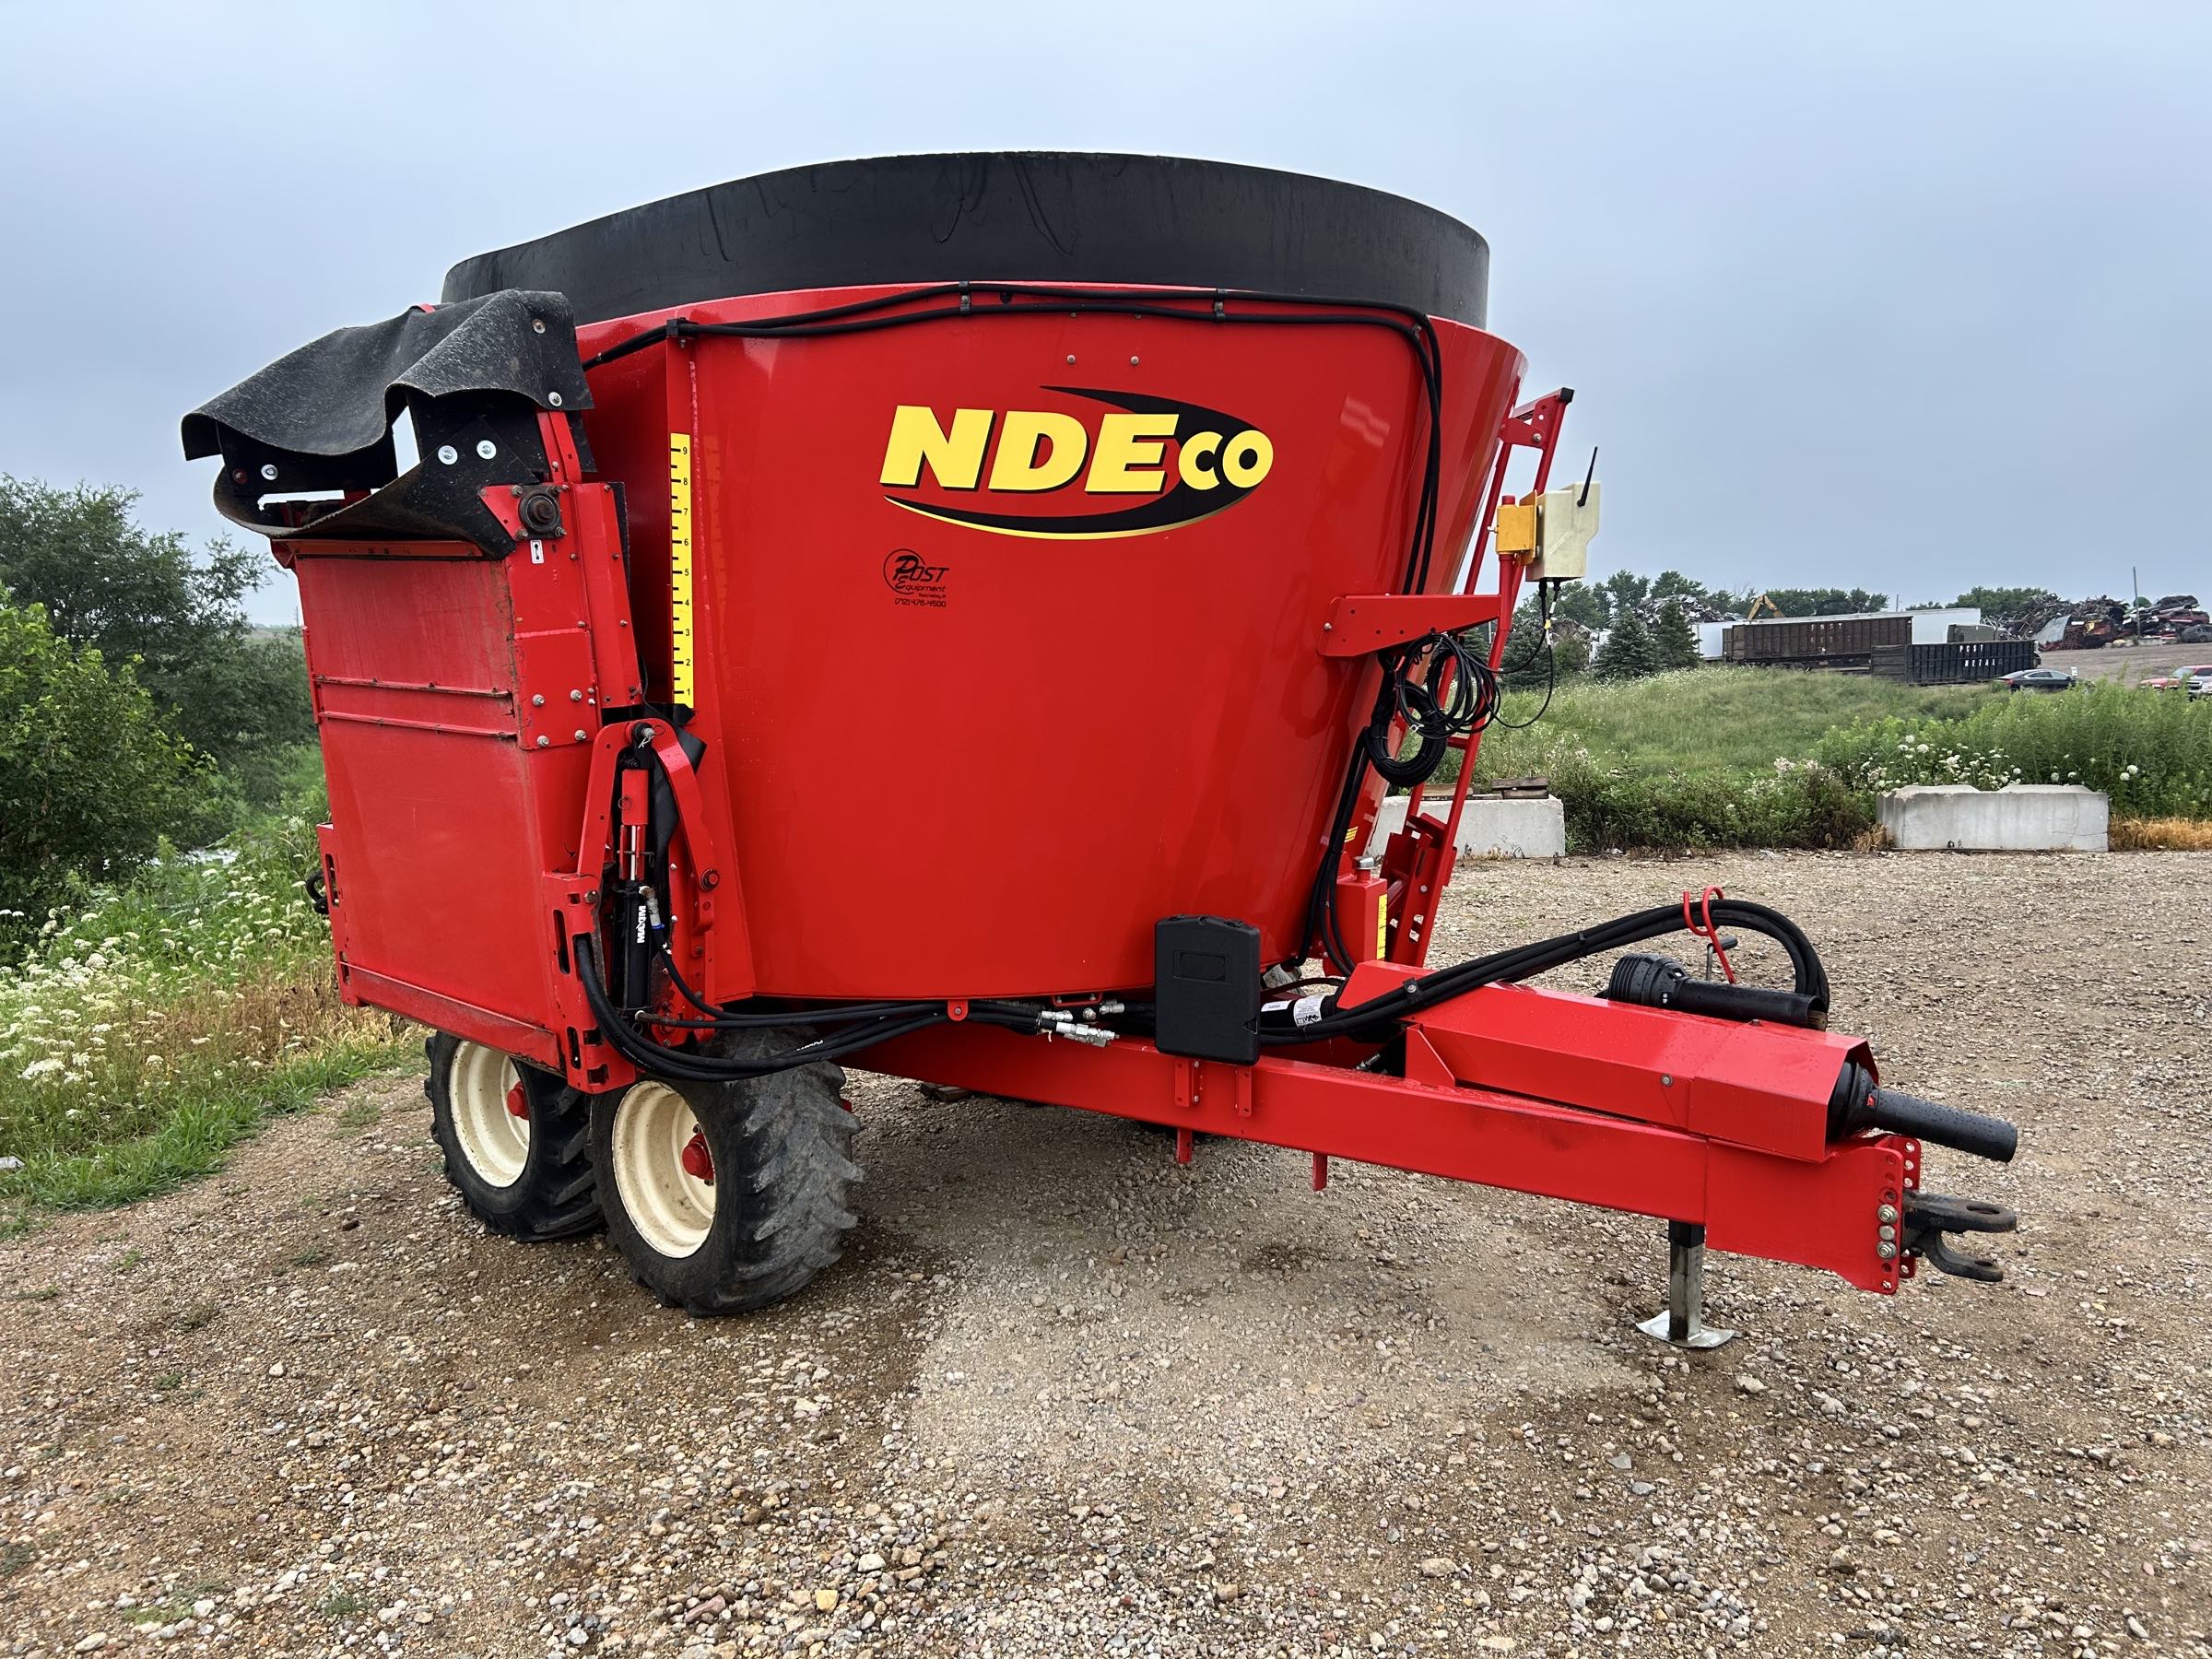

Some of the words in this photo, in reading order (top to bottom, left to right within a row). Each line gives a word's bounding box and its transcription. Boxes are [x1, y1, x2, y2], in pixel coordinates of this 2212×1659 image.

[682, 446, 688, 455] 9
[683, 477, 688, 486] 8
[683, 508, 688, 516] 7
[684, 538, 689, 547] 6
[684, 568, 689, 577] 5
[685, 629, 690, 637] 3
[1959, 644, 1984, 653] POST
[686, 658, 691, 666] 2
[636, 905, 647, 944] MAXIM
